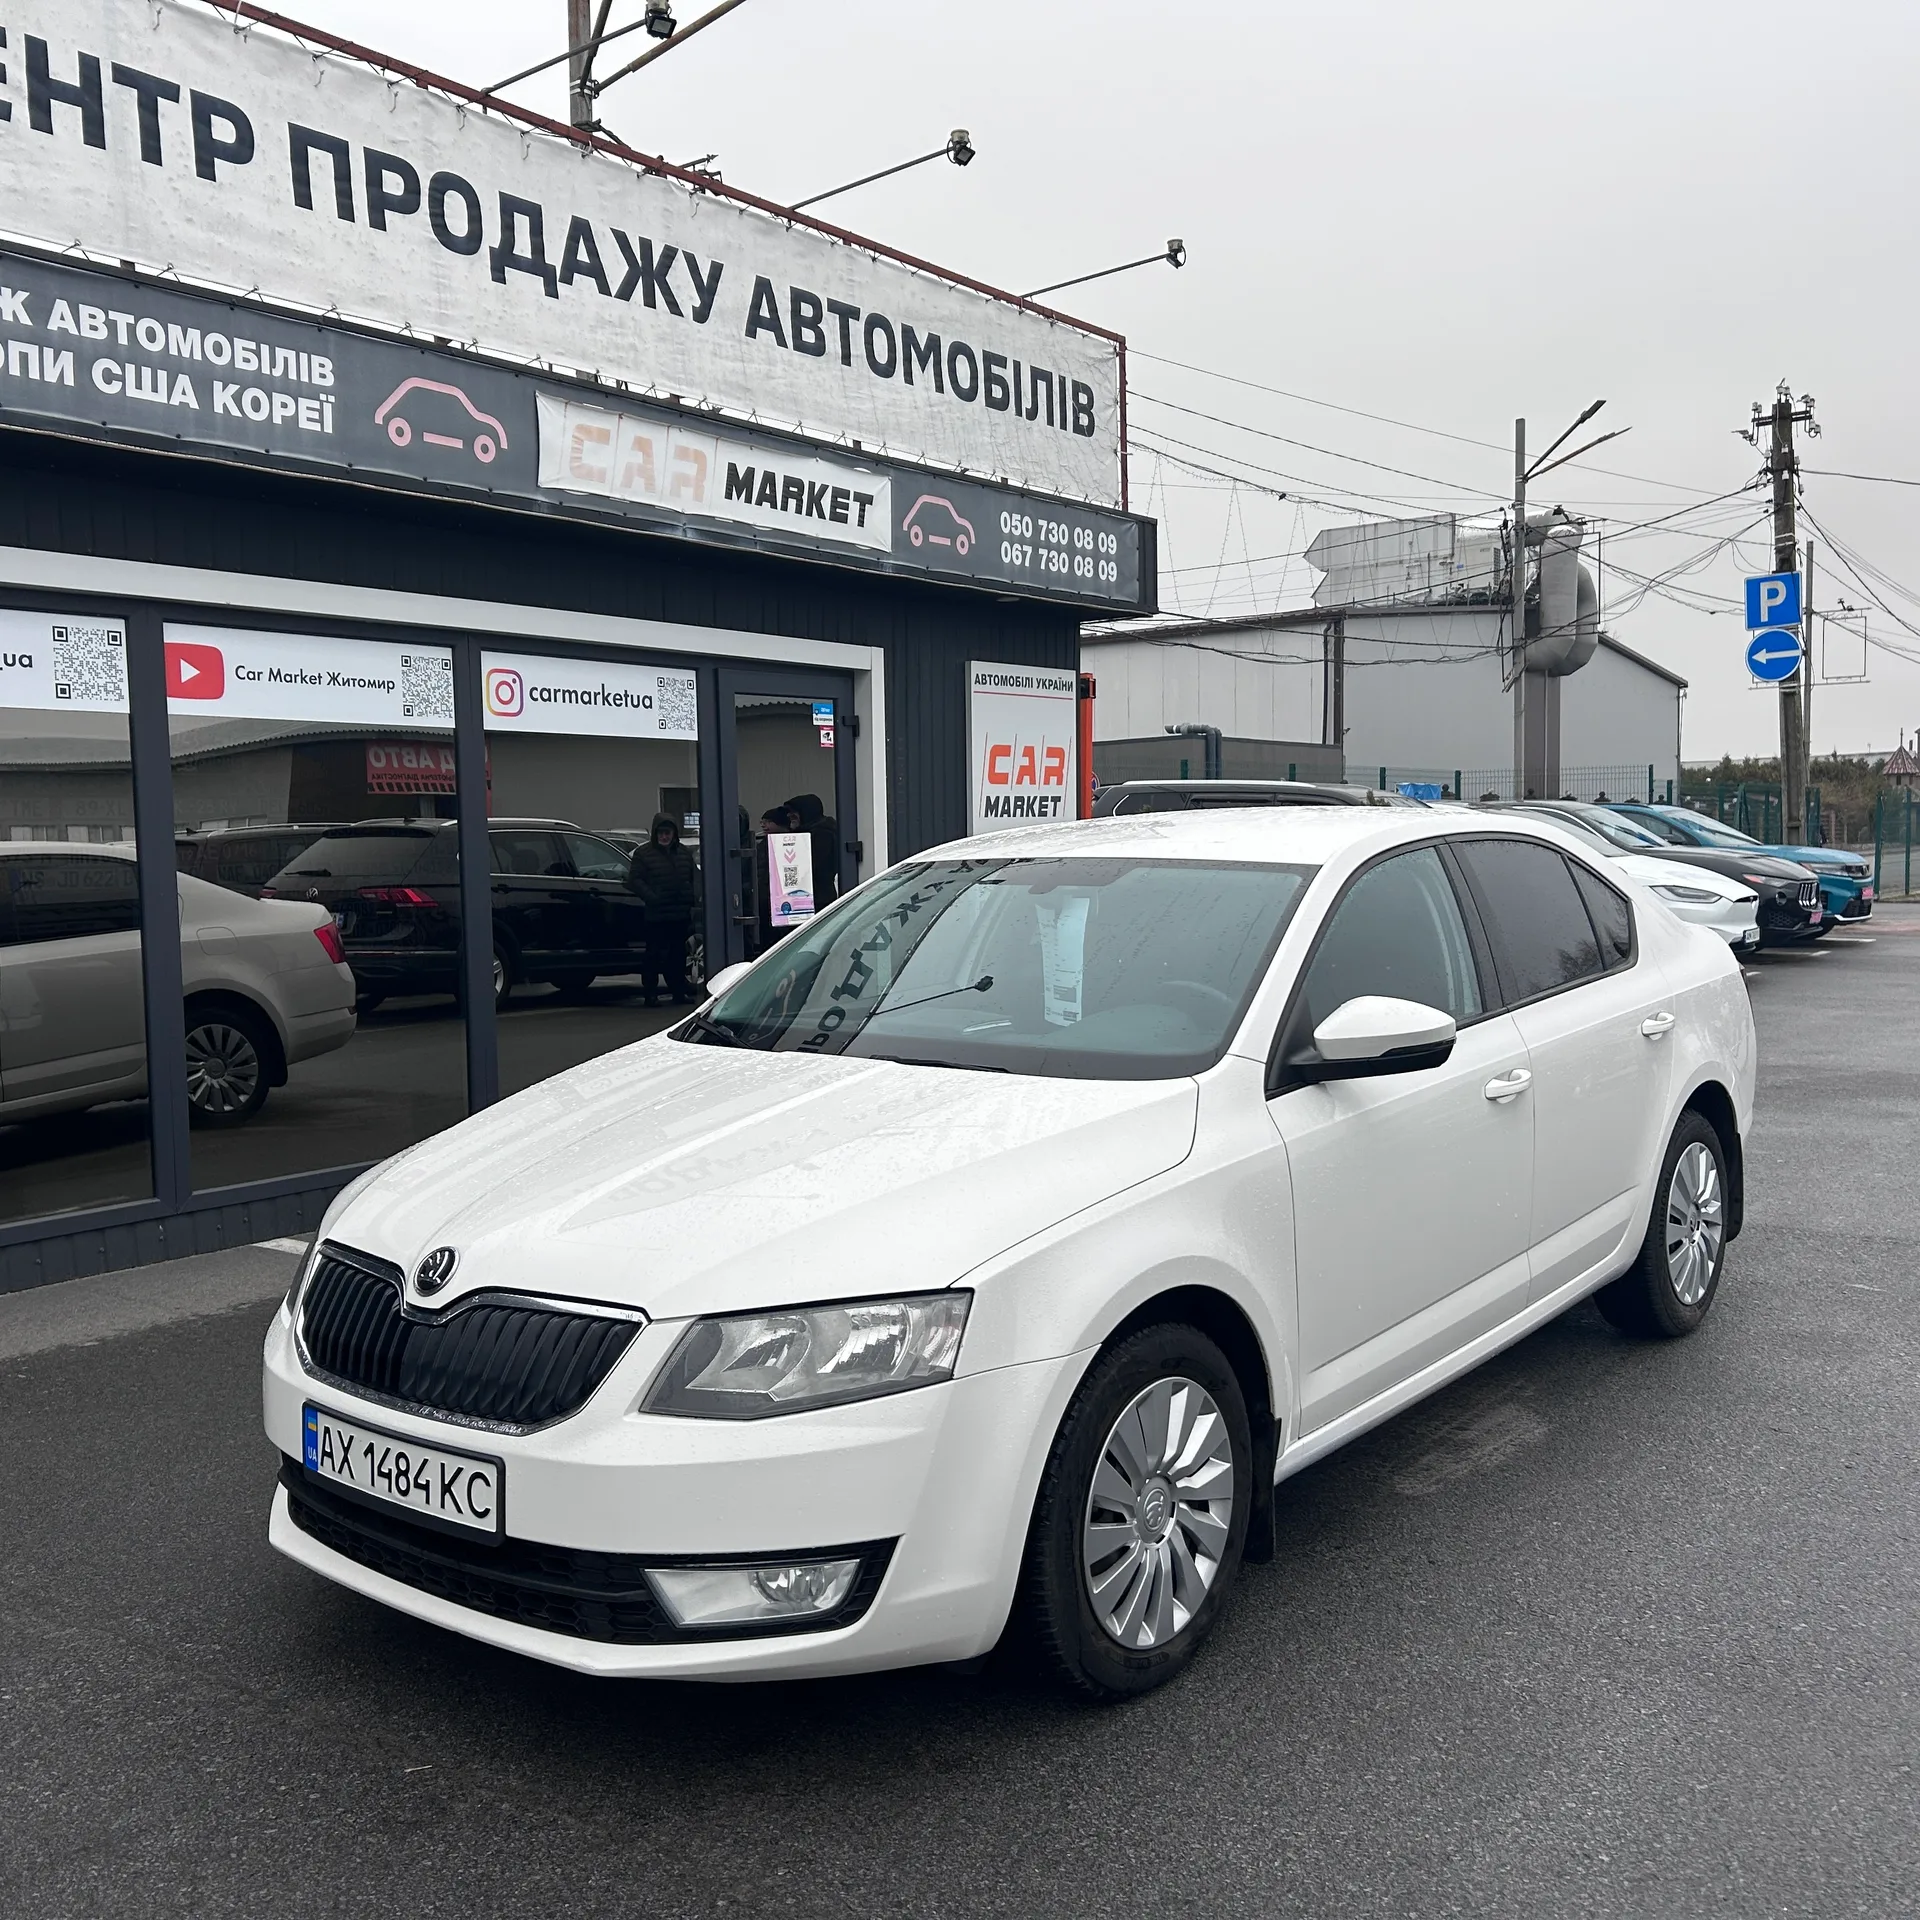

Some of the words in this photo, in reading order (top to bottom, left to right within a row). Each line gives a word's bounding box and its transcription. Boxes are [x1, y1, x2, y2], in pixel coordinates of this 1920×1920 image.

[0, 26, 256, 183] НТР
[287, 121, 724, 324] ПРОДАЖУ
[744, 275, 1096, 438] АВТОМОБІЛІВ
[47, 298, 335, 388] АВТОМОБІЛІВ
[0, 339, 75, 387] ПИ
[91, 357, 207, 410] США
[213, 380, 336, 434] КОРЕЇ
[569, 423, 708, 503] CAR
[724, 461, 874, 528] MARKET
[1000, 511, 1033, 538] 050
[1038, 519, 1069, 545] 730
[1073, 527, 1094, 550] 08
[1097, 532, 1117, 555] 09
[1000, 541, 1033, 567] 067
[1038, 548, 1069, 574] 730
[1073, 555, 1094, 578] 08
[1098, 559, 1118, 582] 09
[1760, 580, 1787, 622] P
[235, 665, 263, 681] Car
[268, 667, 323, 686] Market
[326, 671, 396, 694] Житомир
[528, 683, 654, 710] carmarketua
[974, 672, 1034, 689] АВТОМОБІЛІ
[1036, 676, 1074, 692] УКРАЇНИ
[987, 744, 1066, 786] CAR
[984, 795, 1061, 818] MARKET
[307, 1445, 317, 1461] UA
[320, 1426, 354, 1480] AX
[362, 1442, 431, 1505] 1484
[440, 1462, 492, 1519] KC
